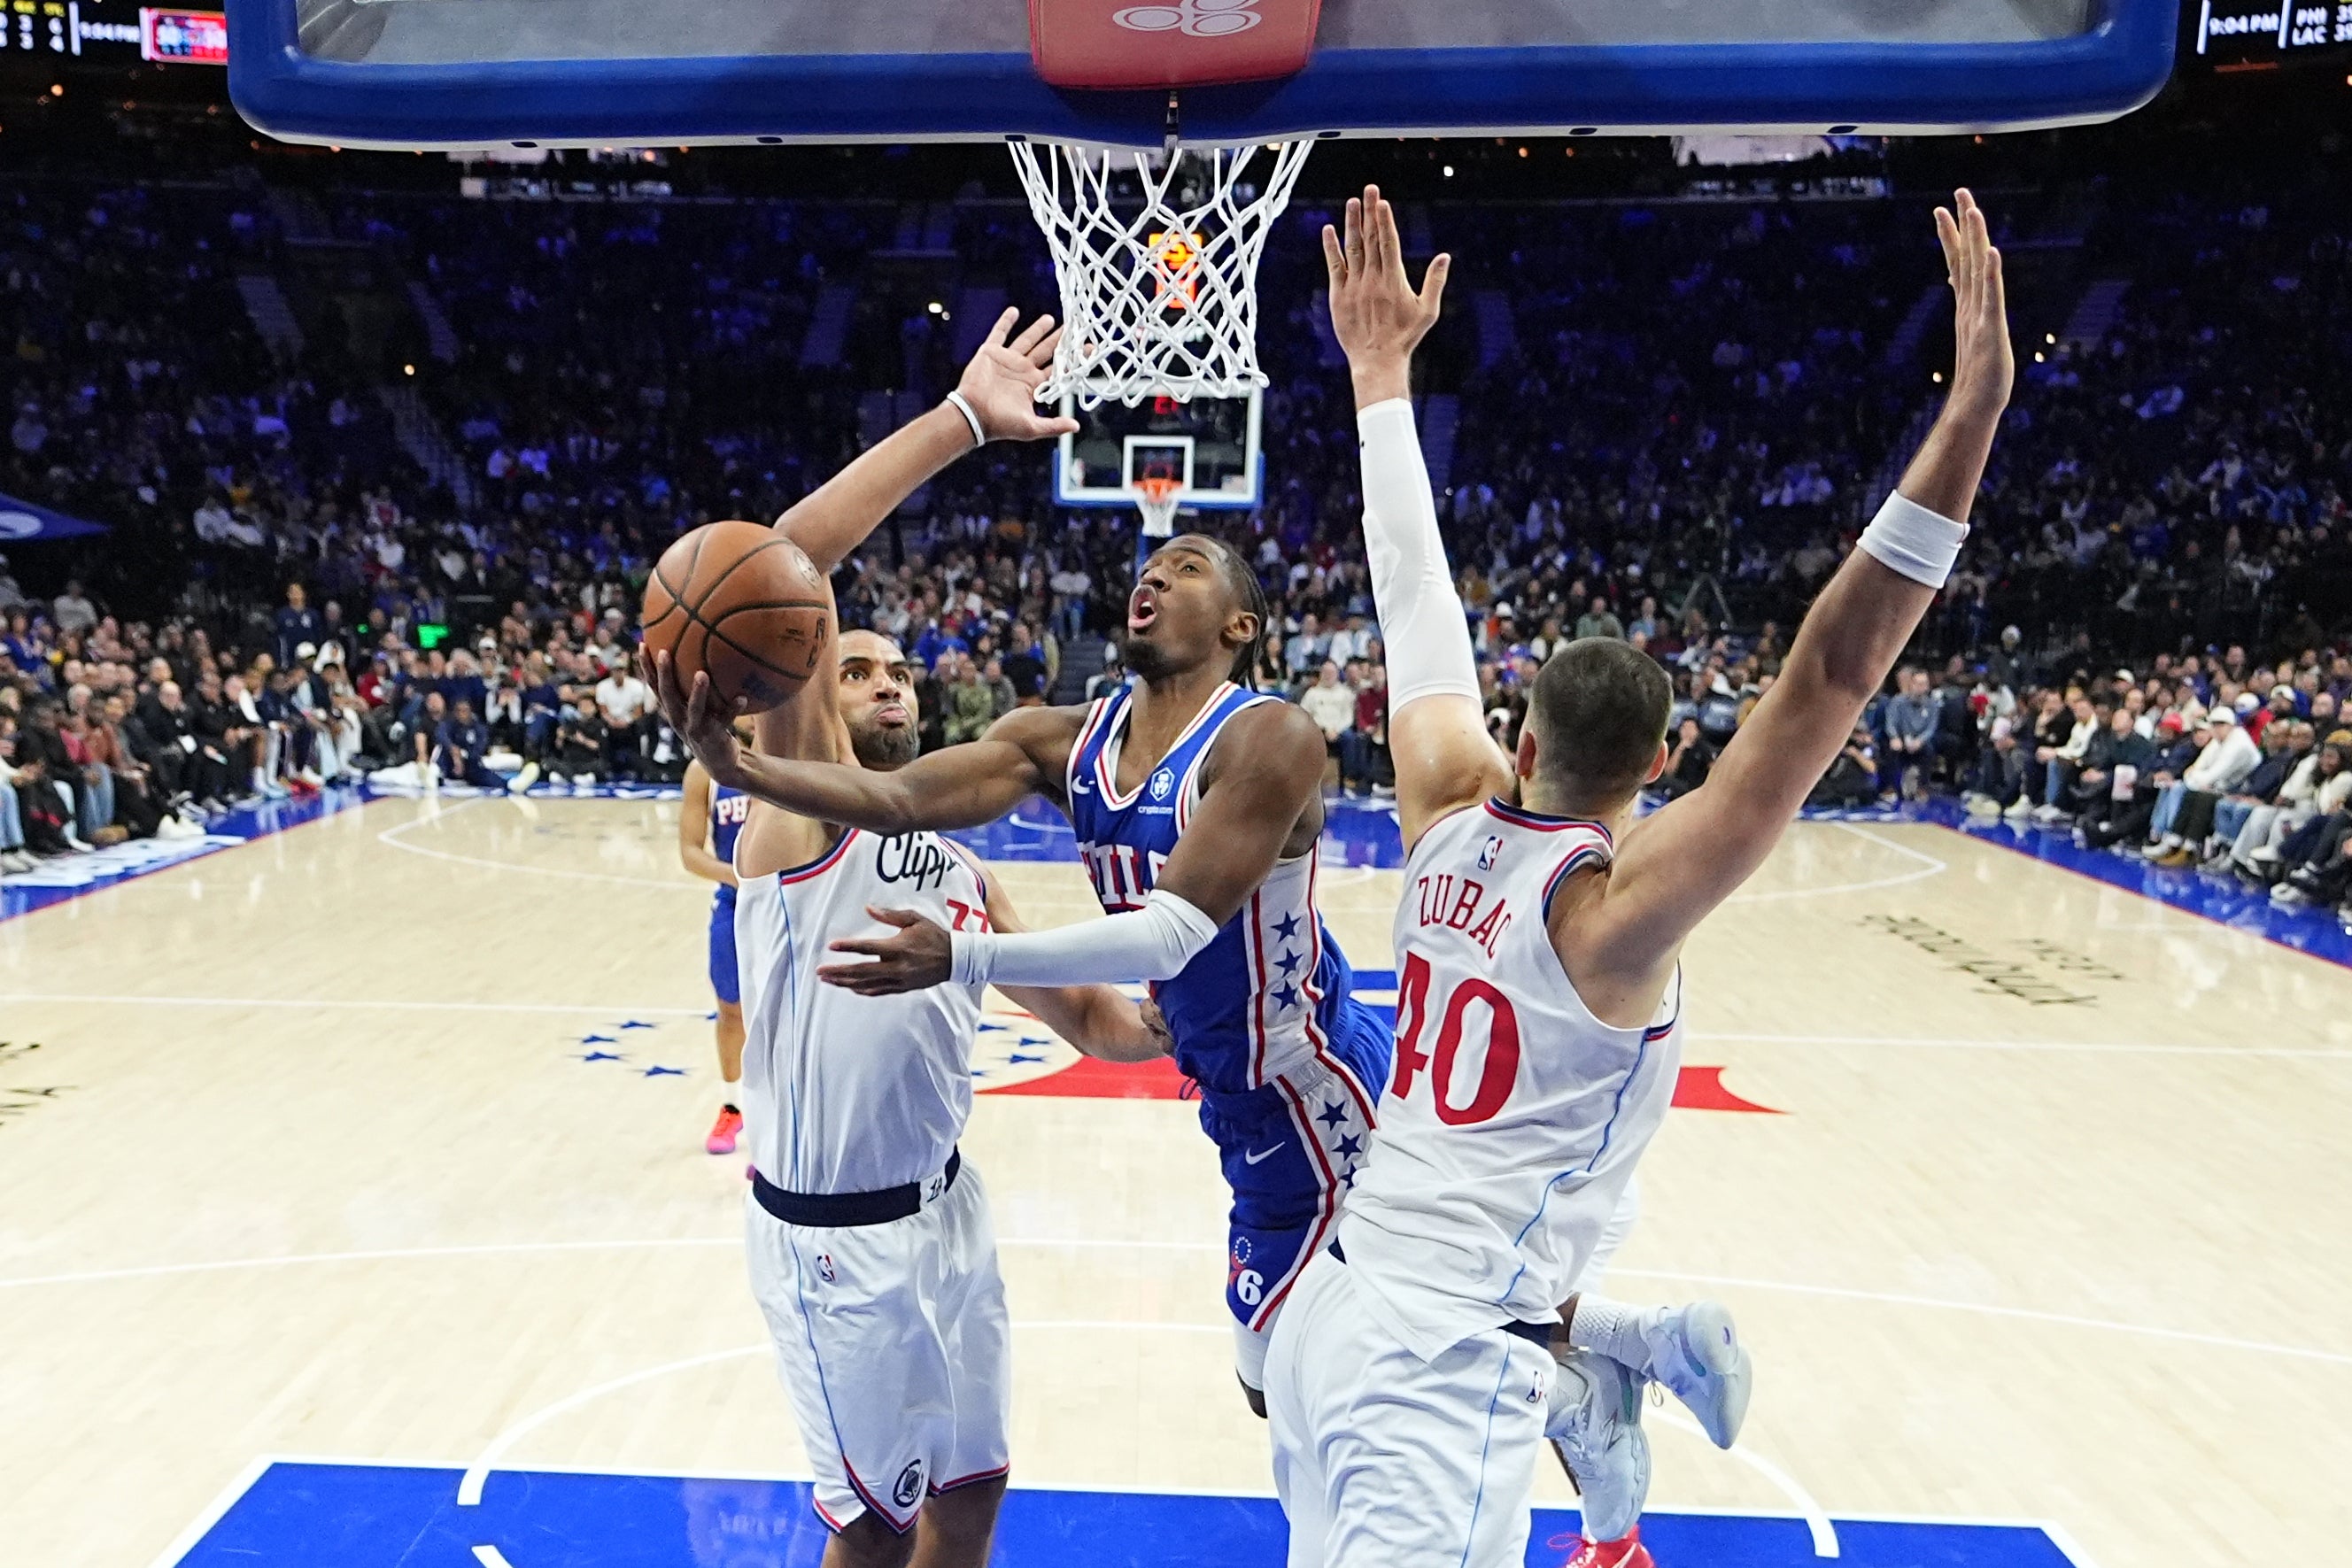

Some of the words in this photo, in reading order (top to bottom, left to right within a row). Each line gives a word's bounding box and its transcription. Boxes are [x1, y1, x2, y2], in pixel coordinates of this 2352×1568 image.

[2292, 26, 2327, 45] LAC
[1137, 805, 1174, 815] crypto.com
[876, 831, 963, 892] Clipp
[1391, 950, 1520, 1126] 40
